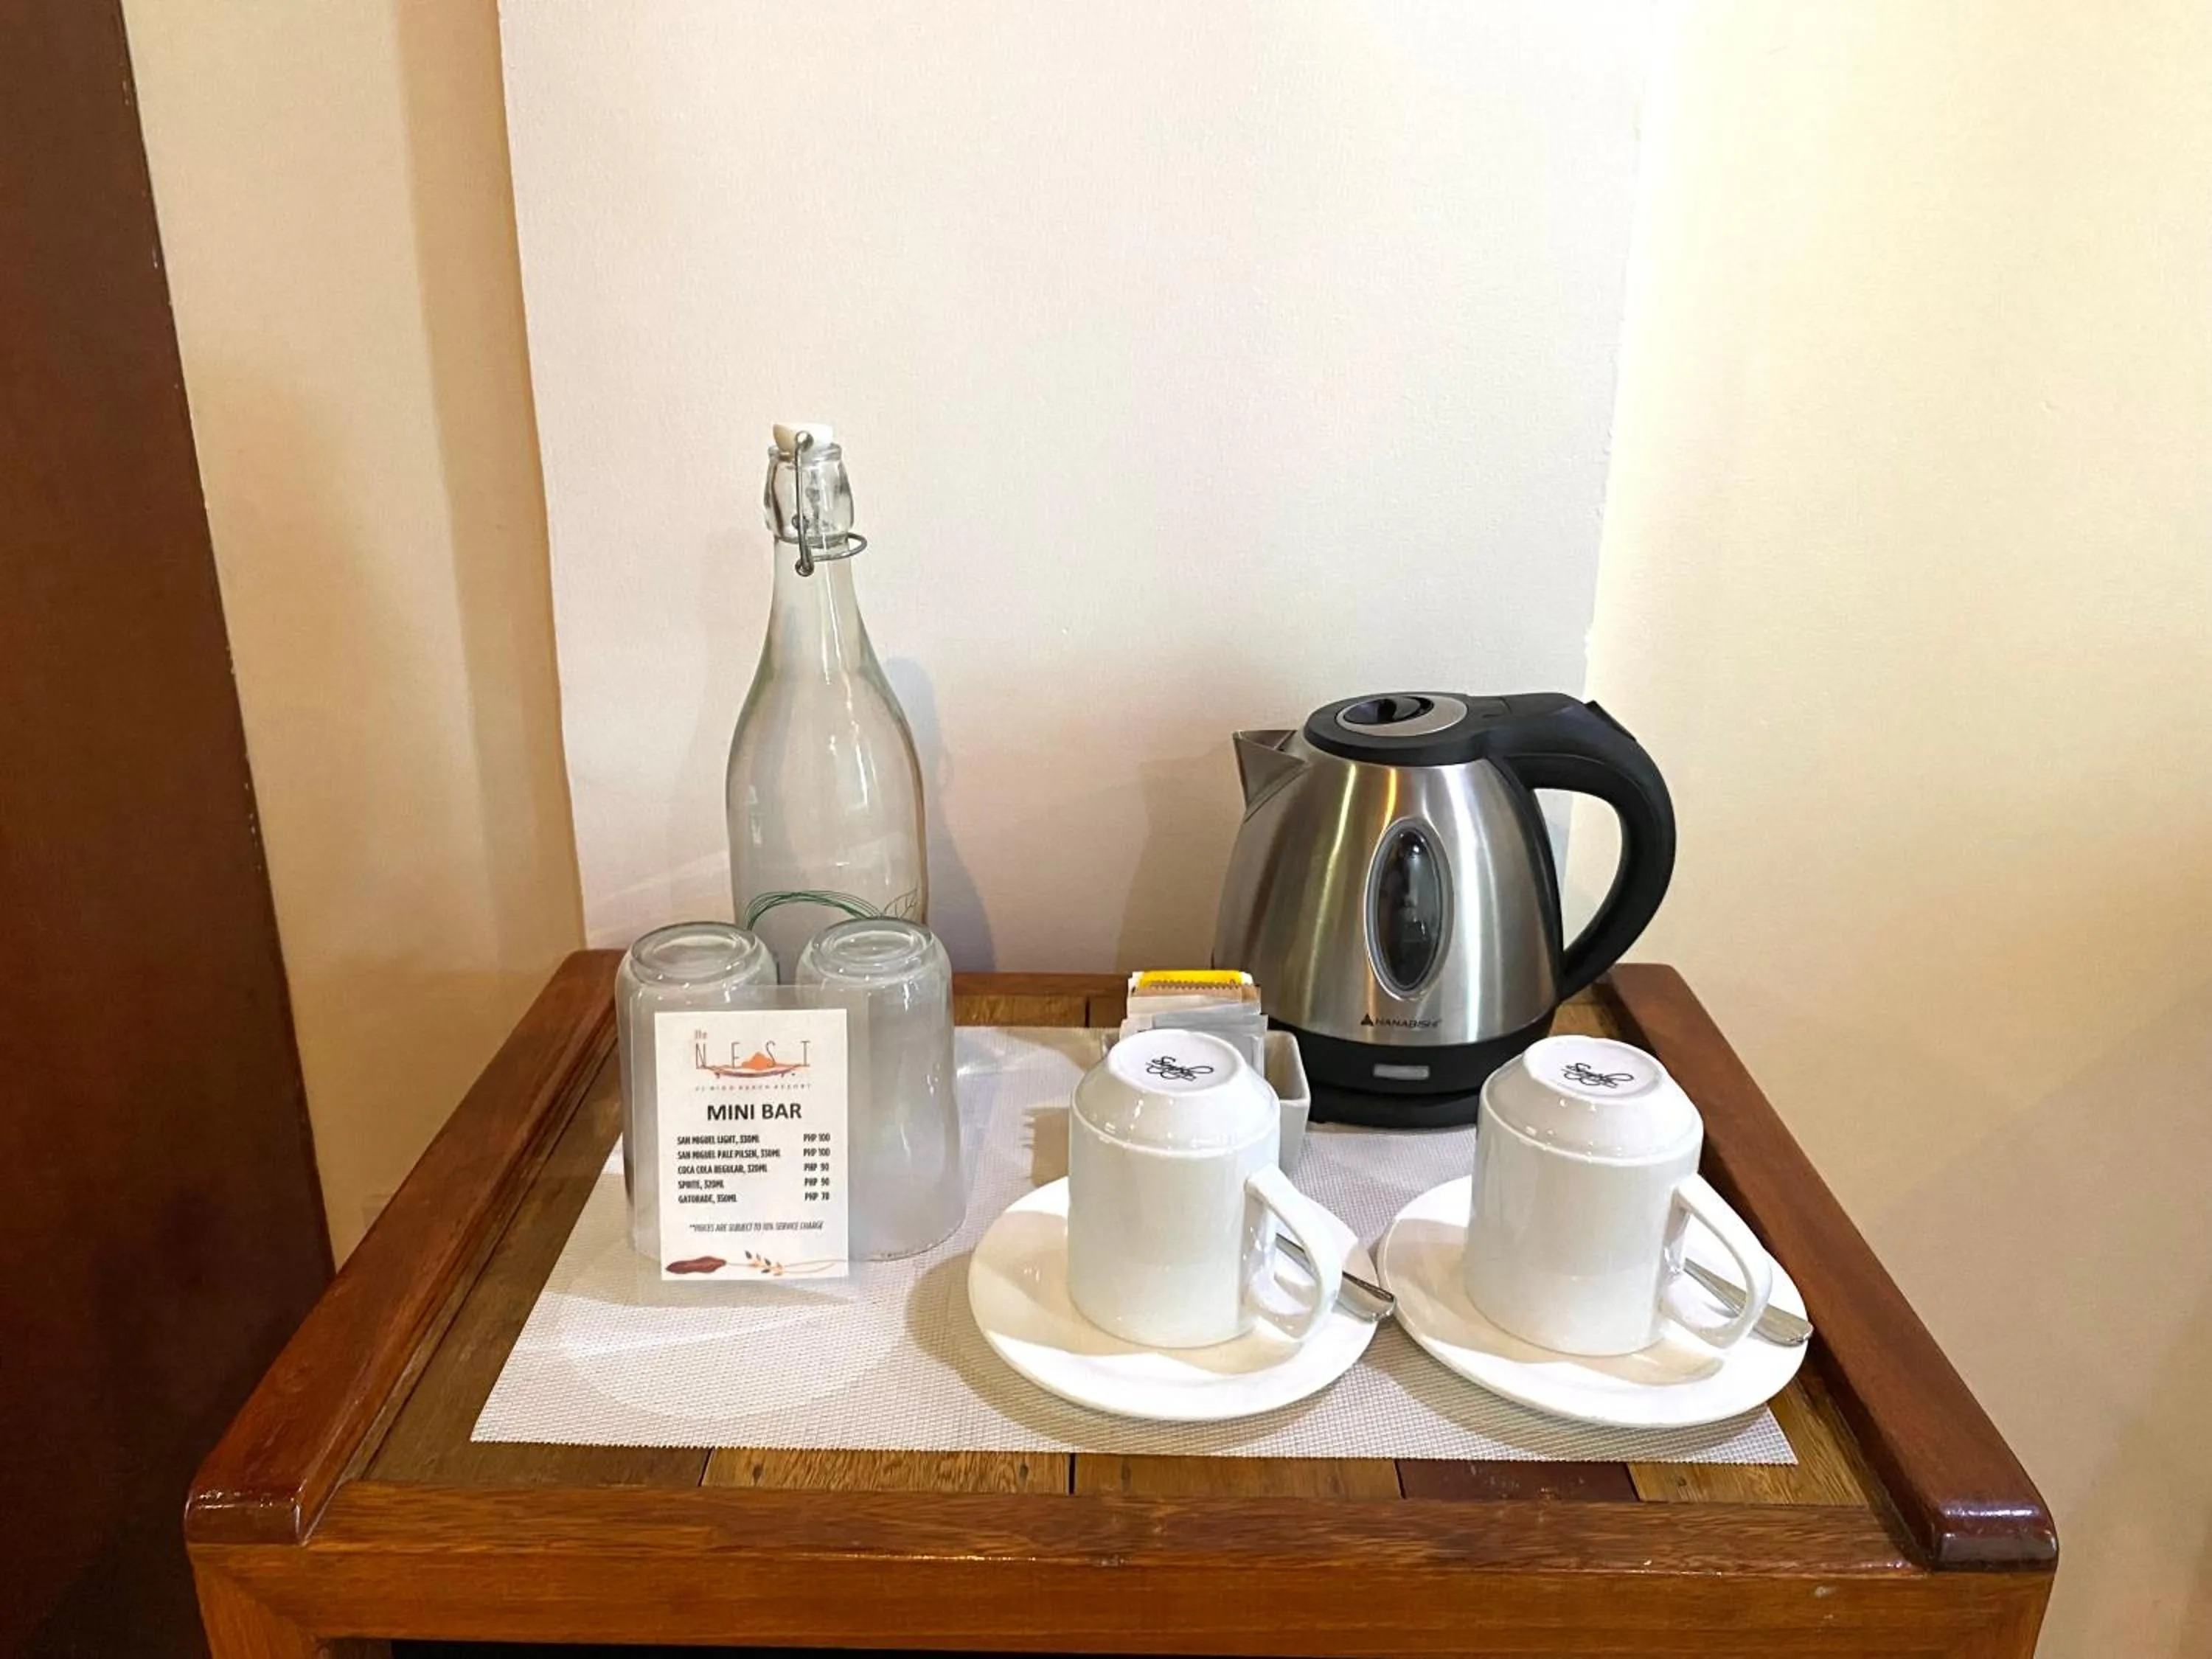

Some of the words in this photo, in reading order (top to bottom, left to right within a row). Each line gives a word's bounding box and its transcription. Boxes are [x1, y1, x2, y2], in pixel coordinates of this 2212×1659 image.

[695, 1040, 811, 1069] NEST
[707, 1105, 754, 1121] MINI
[762, 1103, 802, 1119] BAR
[678, 1136, 690, 1144] SAN
[692, 1135, 715, 1144] MIGUEL
[717, 1135, 738, 1145] LIGHT,
[804, 1133, 817, 1142] PHP
[818, 1133, 830, 1142] 100
[678, 1151, 690, 1159] SAN
[692, 1150, 715, 1159] MIGUEL
[717, 1150, 732, 1158] PALE
[734, 1150, 759, 1160] PILSEN,
[804, 1148, 817, 1157] PHP
[818, 1147, 830, 1157] 100
[678, 1166, 695, 1174] COCA
[696, 1165, 712, 1174] COLA
[714, 1164, 745, 1174] REGULAR,
[804, 1163, 817, 1172] PHP
[678, 1180, 702, 1190] SPRITE,
[804, 1177, 818, 1186] PHP
[678, 1194, 715, 1204] GATORADE,
[804, 1192, 818, 1201] PHP
